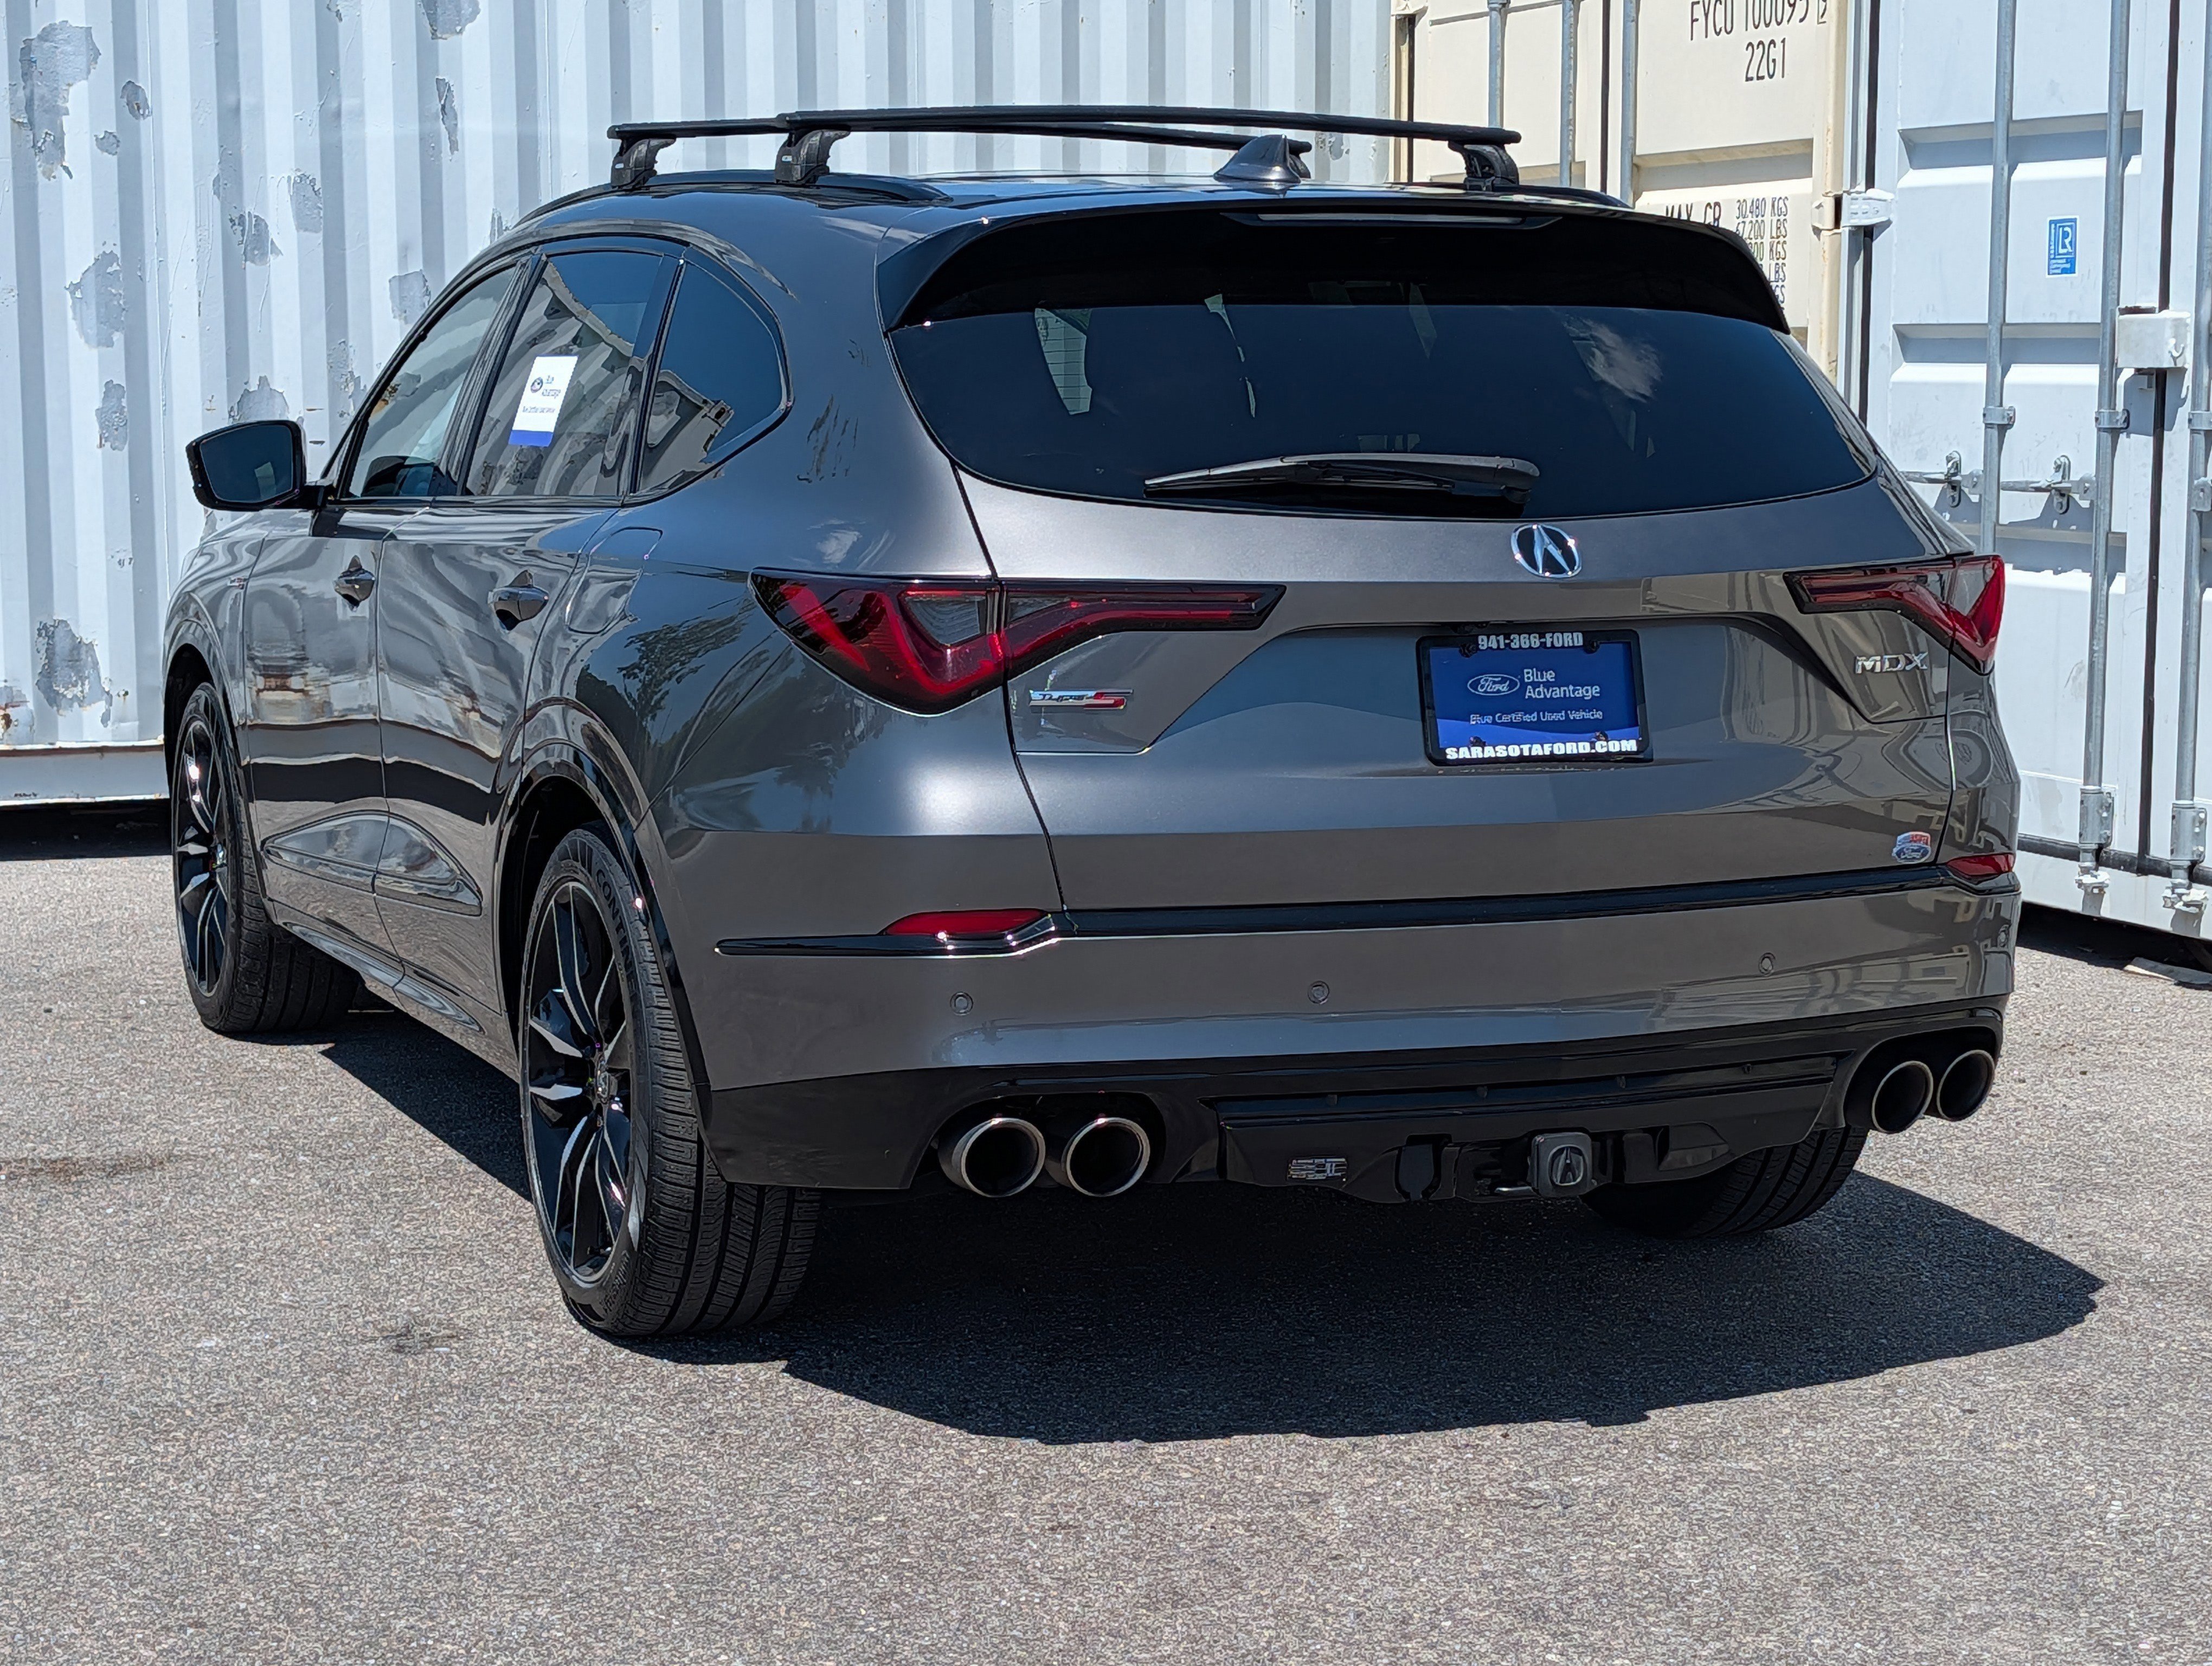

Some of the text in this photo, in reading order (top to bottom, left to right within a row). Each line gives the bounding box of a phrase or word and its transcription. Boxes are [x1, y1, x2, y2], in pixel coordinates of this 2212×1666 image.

[1690, 0, 1734, 41] FYCU
[1745, 37, 1786, 82] 22G1
[1770, 196, 1789, 217] KGS
[1770, 218, 1787, 239] LBS
[1769, 240, 1787, 261] KGS
[1768, 262, 1786, 283] LBS
[1478, 632, 1584, 650] 941-366-FORD
[1855, 651, 1929, 674] MDX
[1477, 668, 1555, 693] Ford Blue
[1525, 684, 1600, 700] Advantage
[1470, 714, 1493, 725] Blue
[1540, 710, 1566, 721] Used
[1445, 739, 1638, 760] SARASOTAFORD.COM
